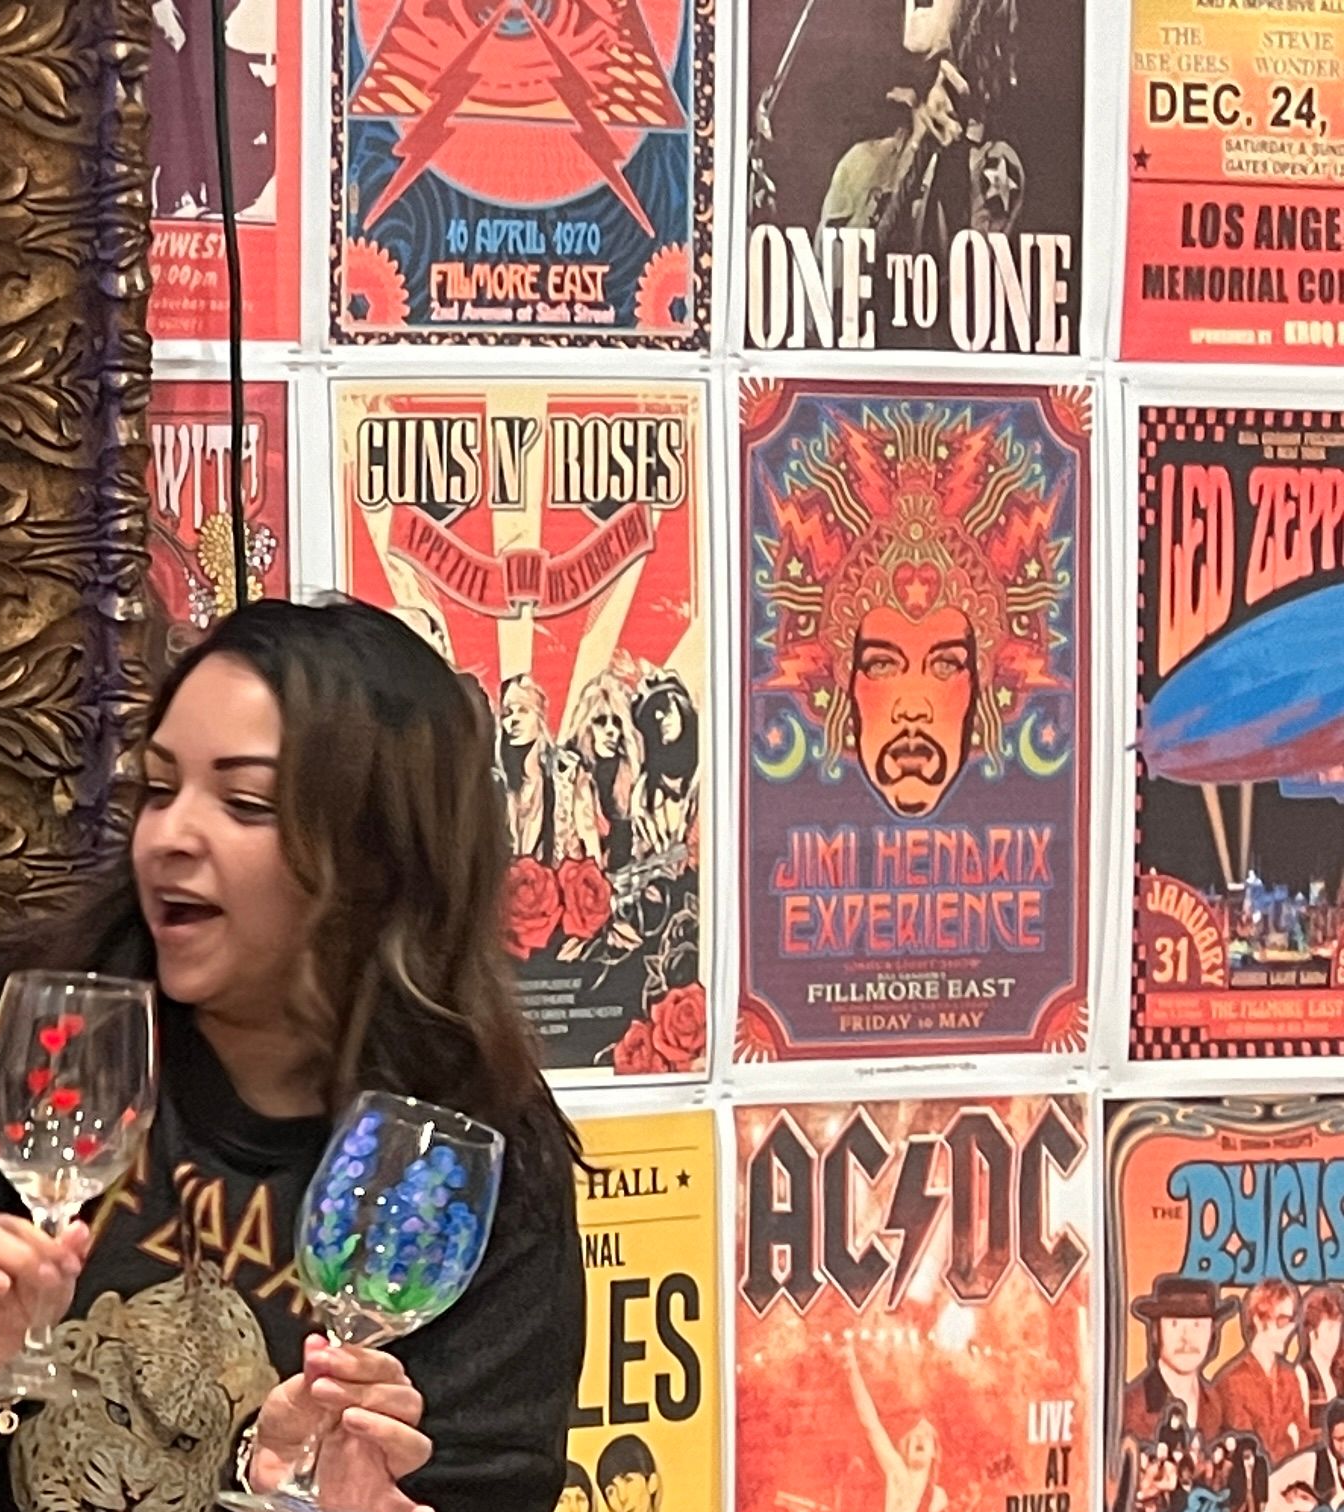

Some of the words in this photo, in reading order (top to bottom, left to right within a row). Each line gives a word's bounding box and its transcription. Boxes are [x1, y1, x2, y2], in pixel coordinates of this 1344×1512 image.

[1162, 26, 1202, 46] THE
[1262, 31, 1334, 51] STEVIE
[1177, 54, 1230, 72] GEES
[1255, 57, 1341, 77] WONDER
[1149, 81, 1253, 127] DEC.
[1270, 85, 1328, 137] 24,
[446, 219, 468, 252] 16
[475, 219, 545, 254] APRIL
[552, 221, 601, 255] 1970
[1181, 202, 1245, 250] LOS
[548, 264, 610, 301] EAST
[747, 224, 876, 349] ONE
[948, 228, 1072, 354] ONE
[1142, 264, 1289, 304] MEMORIAL
[357, 416, 478, 506] GUNS
[490, 416, 542, 508] N'
[551, 415, 685, 506] ROSES
[1158, 463, 1234, 678] LED
[773, 829, 857, 889] JIMI
[876, 827, 1053, 887] HENDRIX
[783, 889, 1041, 954] EXPERIENCE
[1146, 880, 1225, 986] JANUARY
[1152, 937, 1189, 984] 31
[807, 979, 940, 1004] FILLMORE
[948, 978, 1016, 998] EAST
[839, 1014, 912, 1033] FRIDAY
[939, 1011, 984, 1029] MAY
[586, 1166, 669, 1200] HALL
[1027, 1400, 1075, 1445] LIVE
[1044, 1446, 1072, 1488] AT
